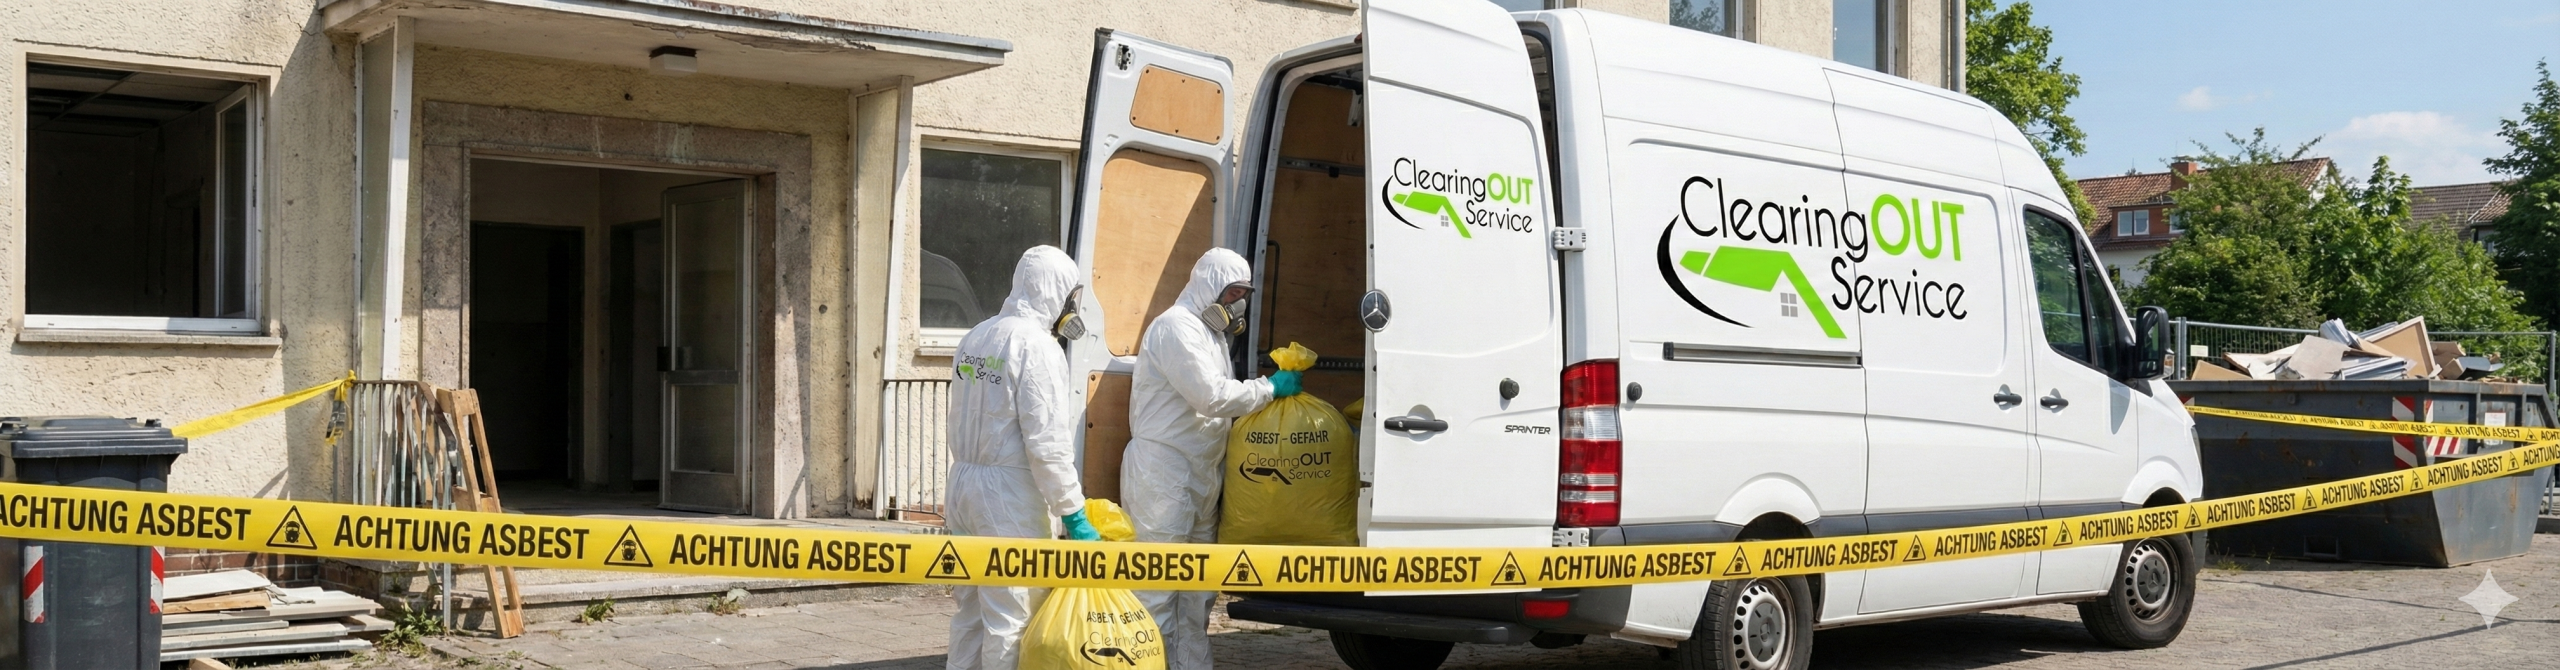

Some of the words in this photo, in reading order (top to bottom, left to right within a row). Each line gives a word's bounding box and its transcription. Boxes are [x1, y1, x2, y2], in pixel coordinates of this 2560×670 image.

[1394, 157, 1533, 205] ClearingOUT
[1466, 200, 1533, 233] Service
[1681, 176, 1965, 263] ClearingOUT
[1831, 256, 1968, 320] Service
[1245, 431, 1280, 444] ASBEST
[1290, 430, 1329, 444] GEFAHR
[1504, 424, 1551, 435] SPRINTER
[1246, 452, 1331, 469] ClearingOUT
[1289, 468, 1331, 480] Service
[2427, 462, 2469, 486] ACHTUNG
[2471, 456, 2502, 477] ASBEST
[2321, 482, 2367, 505] ACHTUNG
[2369, 475, 2404, 497] ASBEST
[136, 502, 251, 541] ASBEST
[2206, 500, 2256, 523] ACHTUNG
[2258, 493, 2295, 516] ASBEST
[334, 515, 470, 554] ACHTUNG
[478, 523, 589, 559] ASBEST
[2079, 516, 2133, 541] ACHTUNG
[2137, 510, 2179, 533] ASBEST
[669, 534, 799, 569] ACHTUNG
[807, 540, 911, 574] ASBEST
[1760, 544, 1836, 571] ACHTUNG
[1839, 540, 1898, 565] ASBEST
[1934, 531, 1996, 557] ACHTUNG
[1999, 526, 2048, 550] ASBEST
[985, 547, 1106, 579] ACHTUNG
[1113, 551, 1209, 581] ASBEST
[1276, 555, 1387, 583] ACHTUNG
[1393, 556, 1482, 583] ASBEST
[1538, 555, 1636, 581] ACHTUNG
[1641, 551, 1716, 577] ASBEST
[1086, 611, 1115, 624] ASBET
